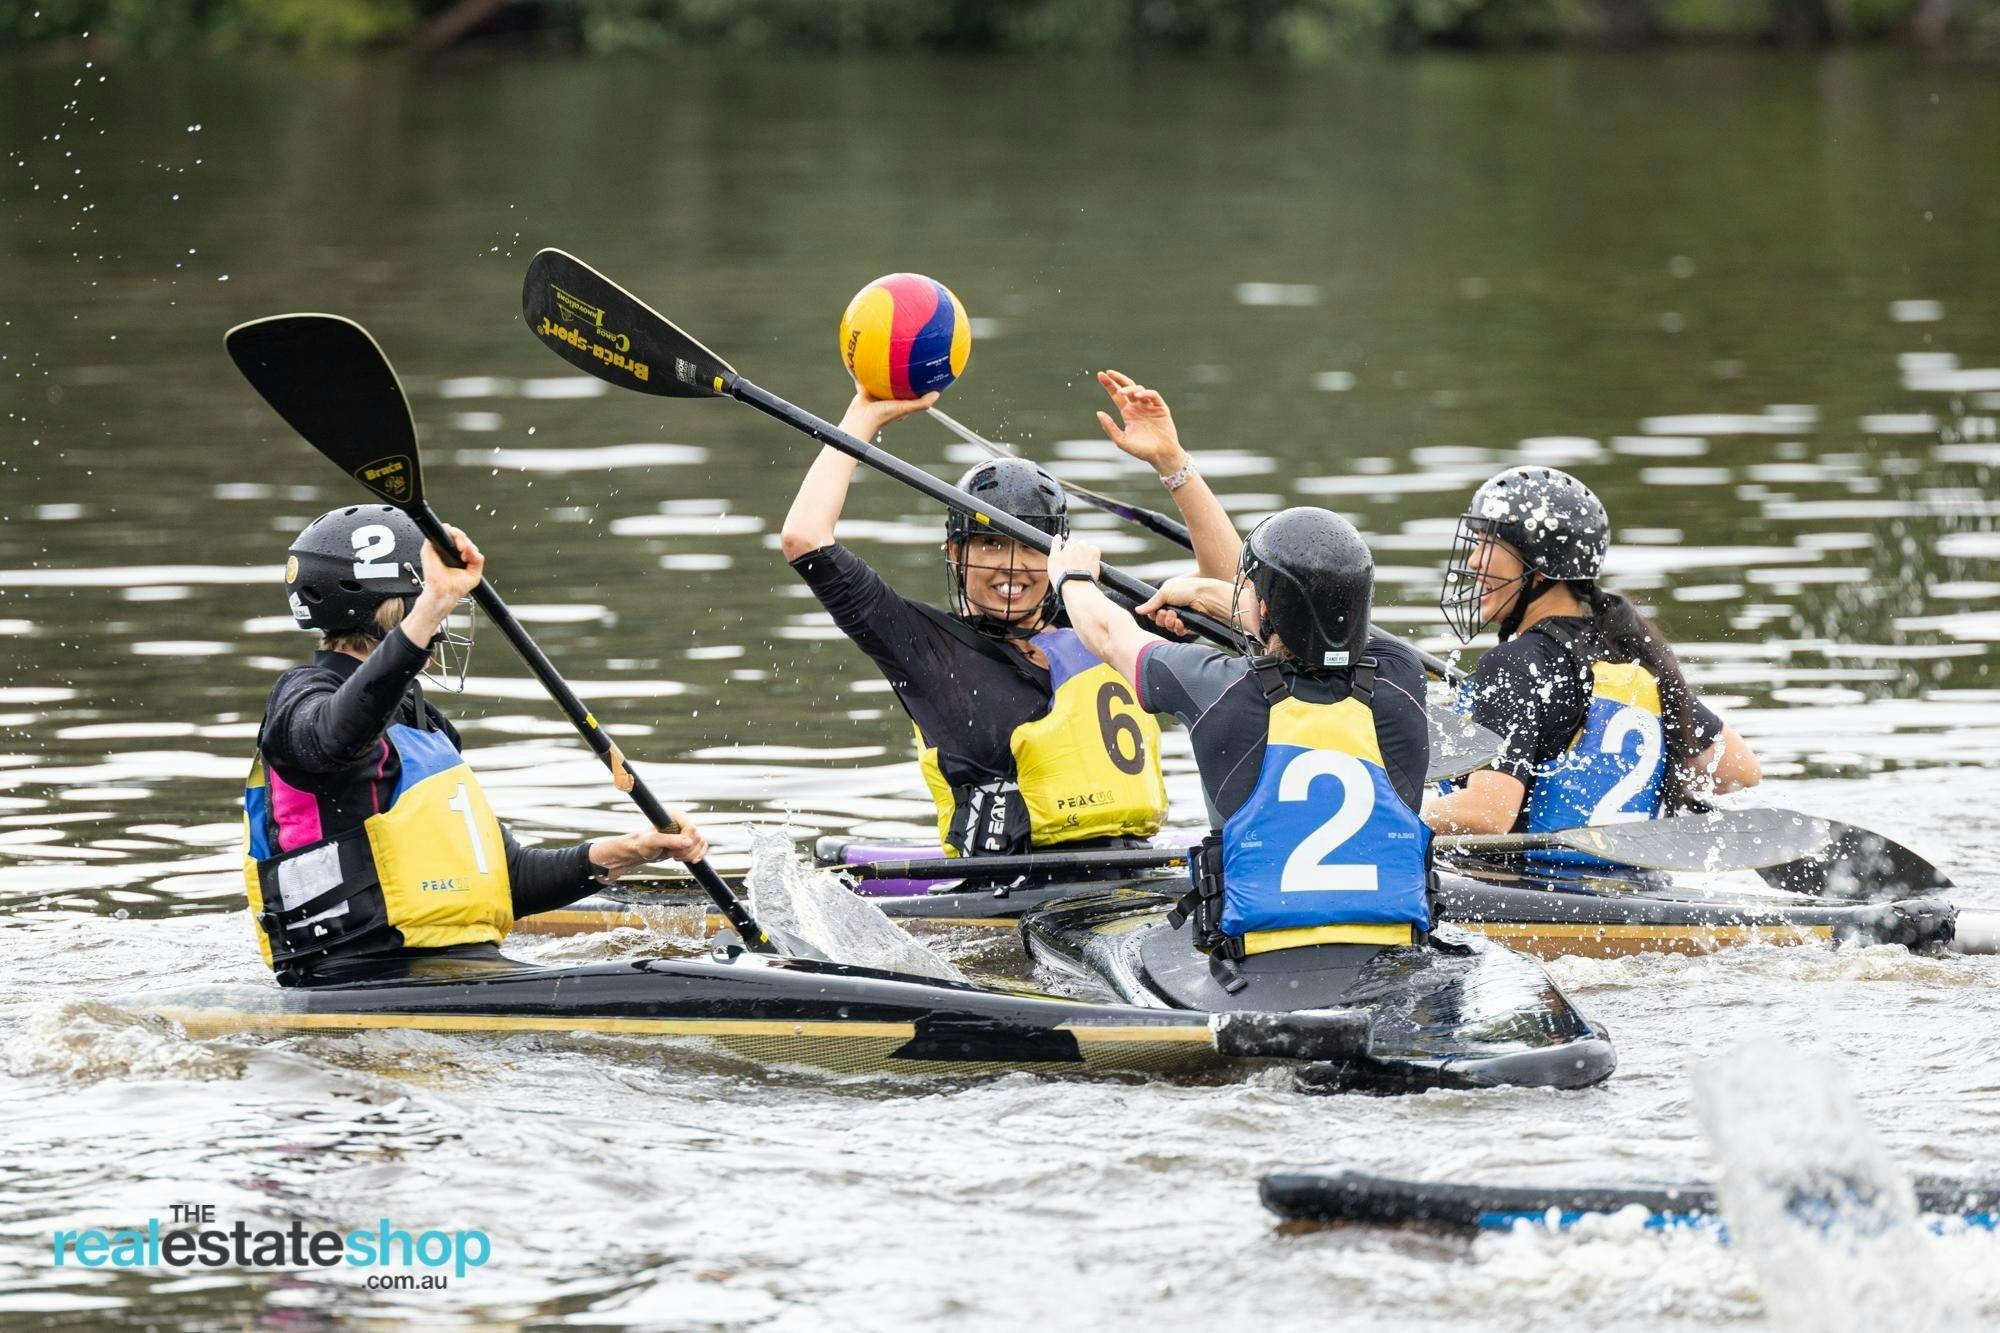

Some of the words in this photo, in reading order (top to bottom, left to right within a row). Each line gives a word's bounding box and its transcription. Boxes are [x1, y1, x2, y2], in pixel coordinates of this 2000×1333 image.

[350, 524, 400, 580] 2
[1096, 681, 1145, 776] 6
[1588, 708, 1664, 827] 2
[447, 782, 489, 875] 1
[985, 794, 1006, 851] PEAK
[1278, 748, 1379, 892] 2
